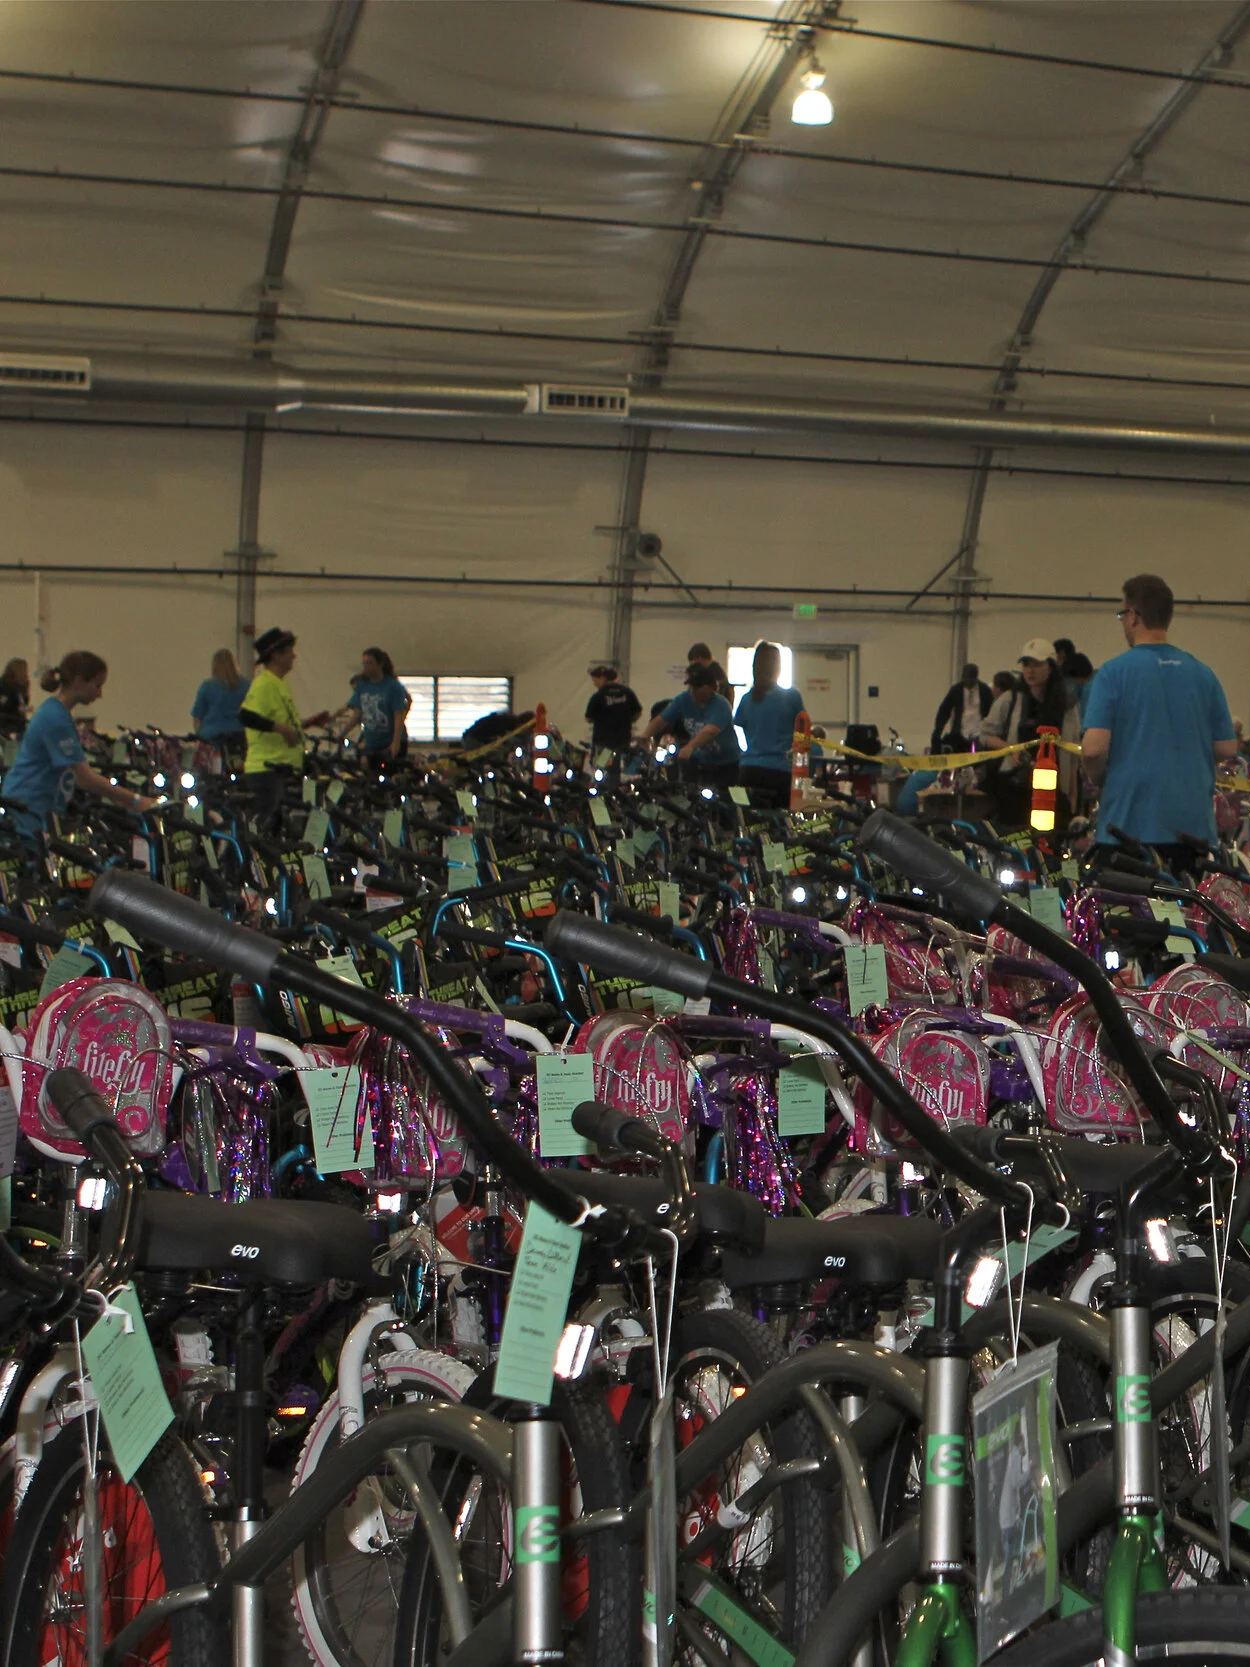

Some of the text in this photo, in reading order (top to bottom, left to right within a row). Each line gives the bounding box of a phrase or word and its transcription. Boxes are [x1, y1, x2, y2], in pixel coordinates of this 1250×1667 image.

[153, 975, 219, 999] HREAT
[82, 1041, 147, 1095] firefly
[616, 1069, 672, 1113] firefly
[230, 1242, 260, 1260] evo
[823, 1254, 846, 1268] evo
